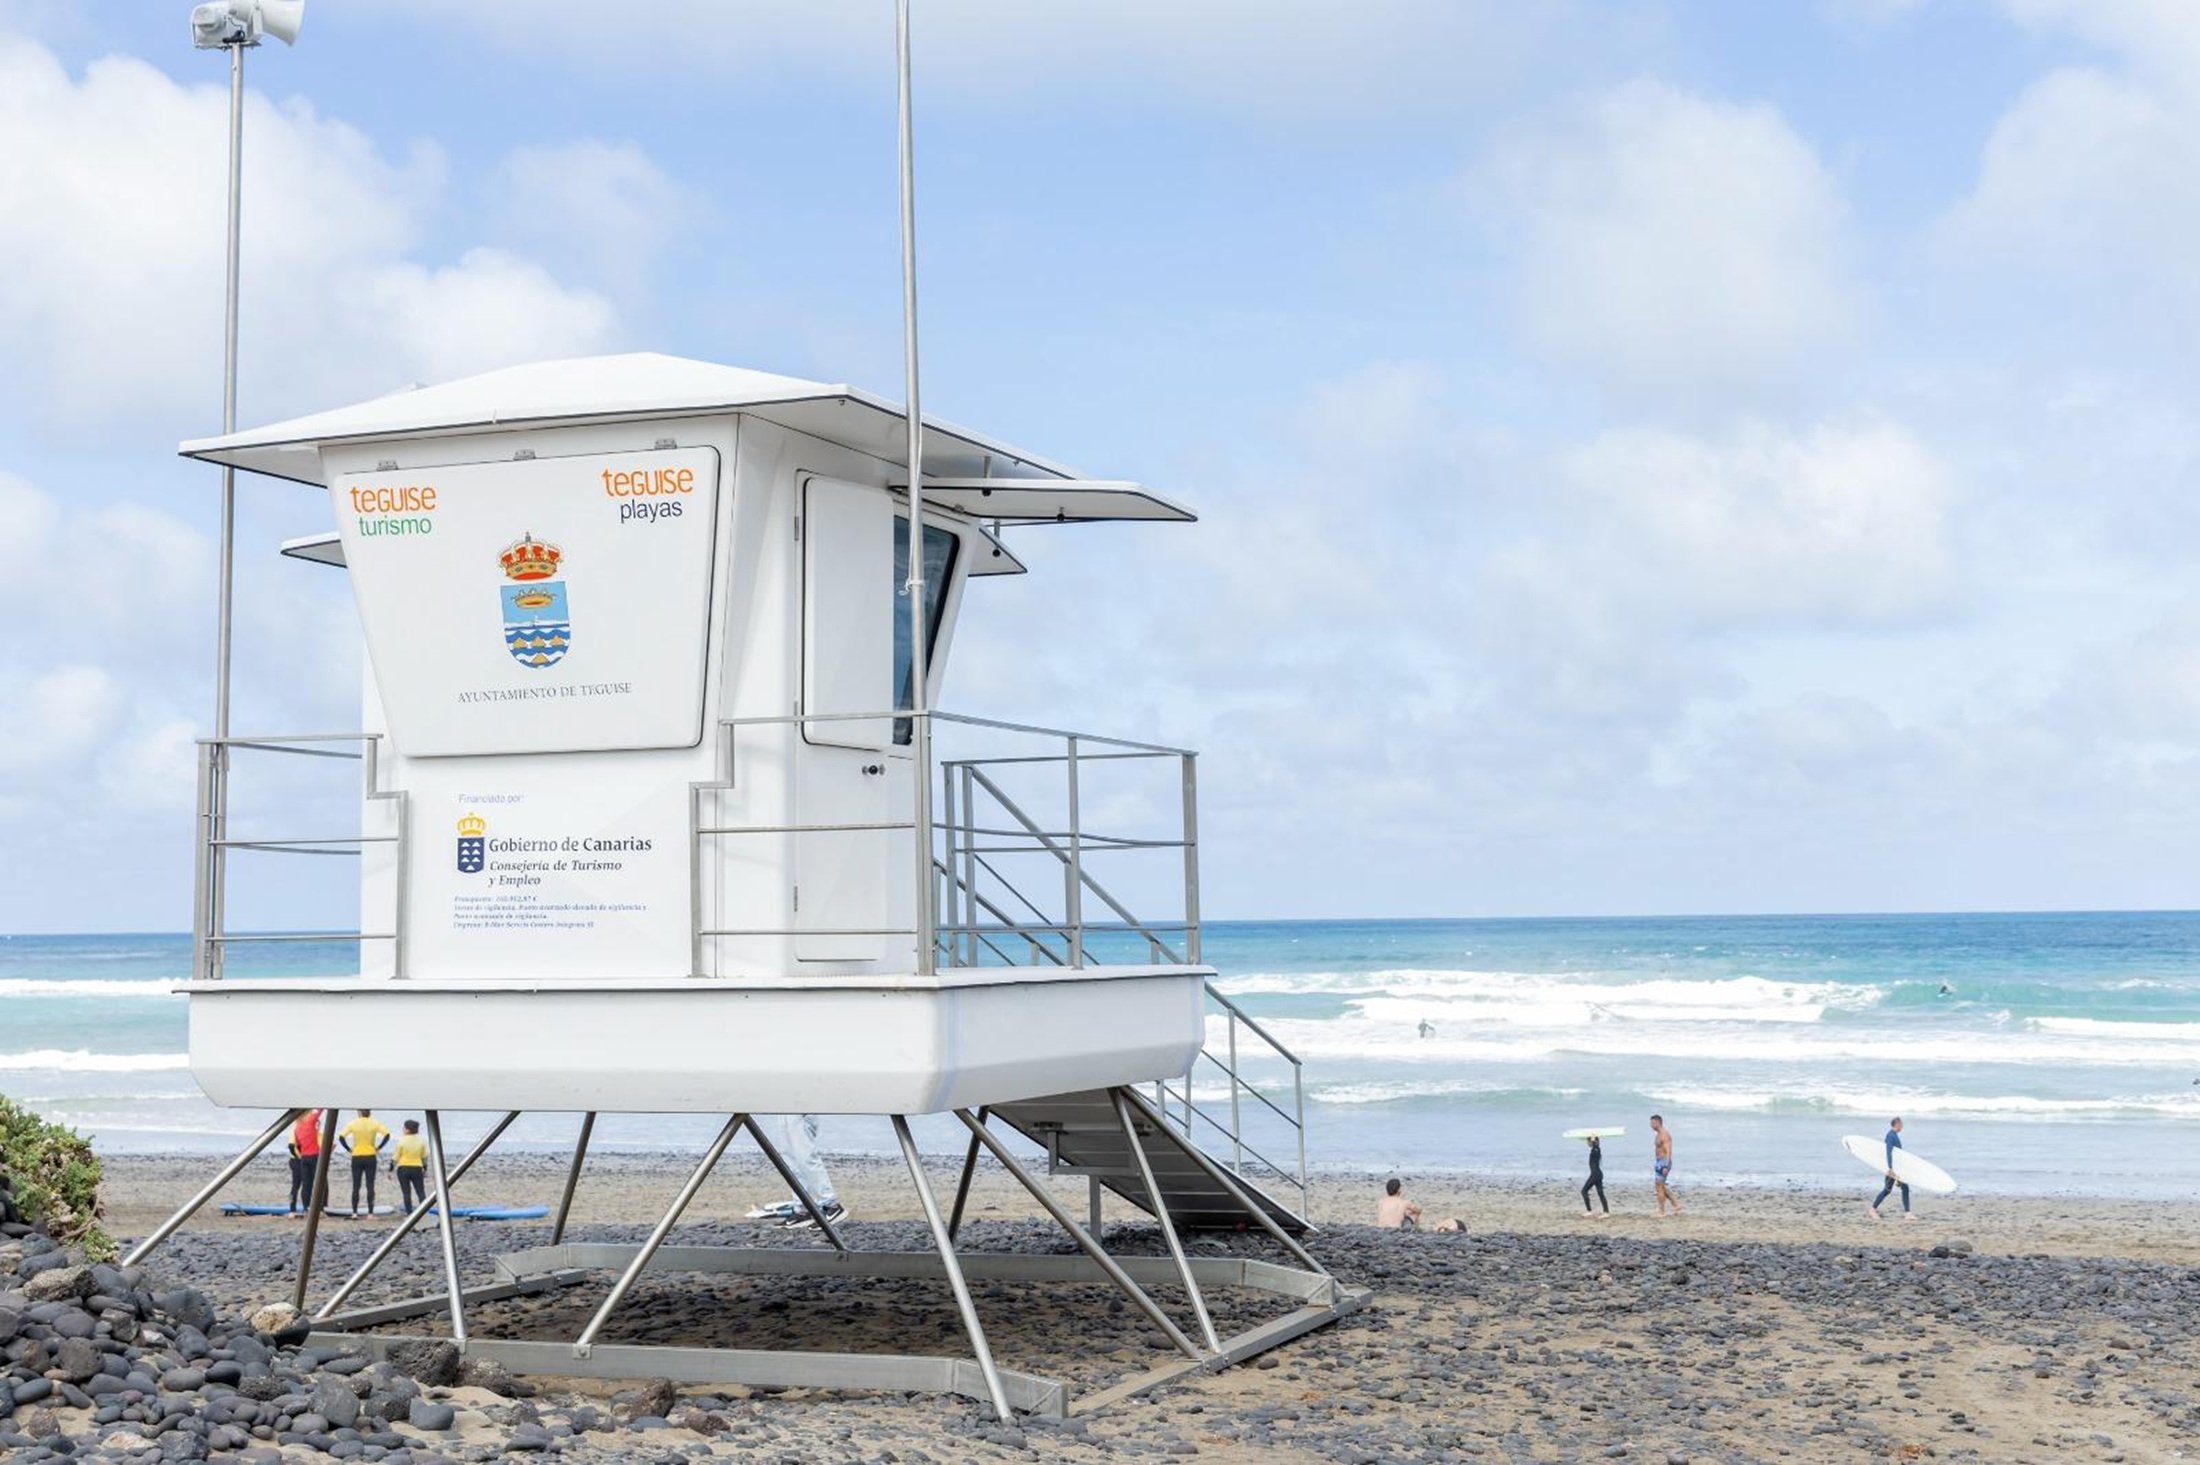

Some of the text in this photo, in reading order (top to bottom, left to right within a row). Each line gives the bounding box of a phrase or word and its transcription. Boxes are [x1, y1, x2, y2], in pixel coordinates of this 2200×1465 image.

[620, 499, 683, 524] playas
[359, 515, 432, 536] turismo
[457, 682, 632, 703] AYUNTAMIENTO DE TEGUISE
[489, 836, 653, 852] Gobierno de Canarias
[553, 859, 567, 871] de
[571, 859, 623, 871] Turismo
[488, 874, 541, 888] y Empleo
